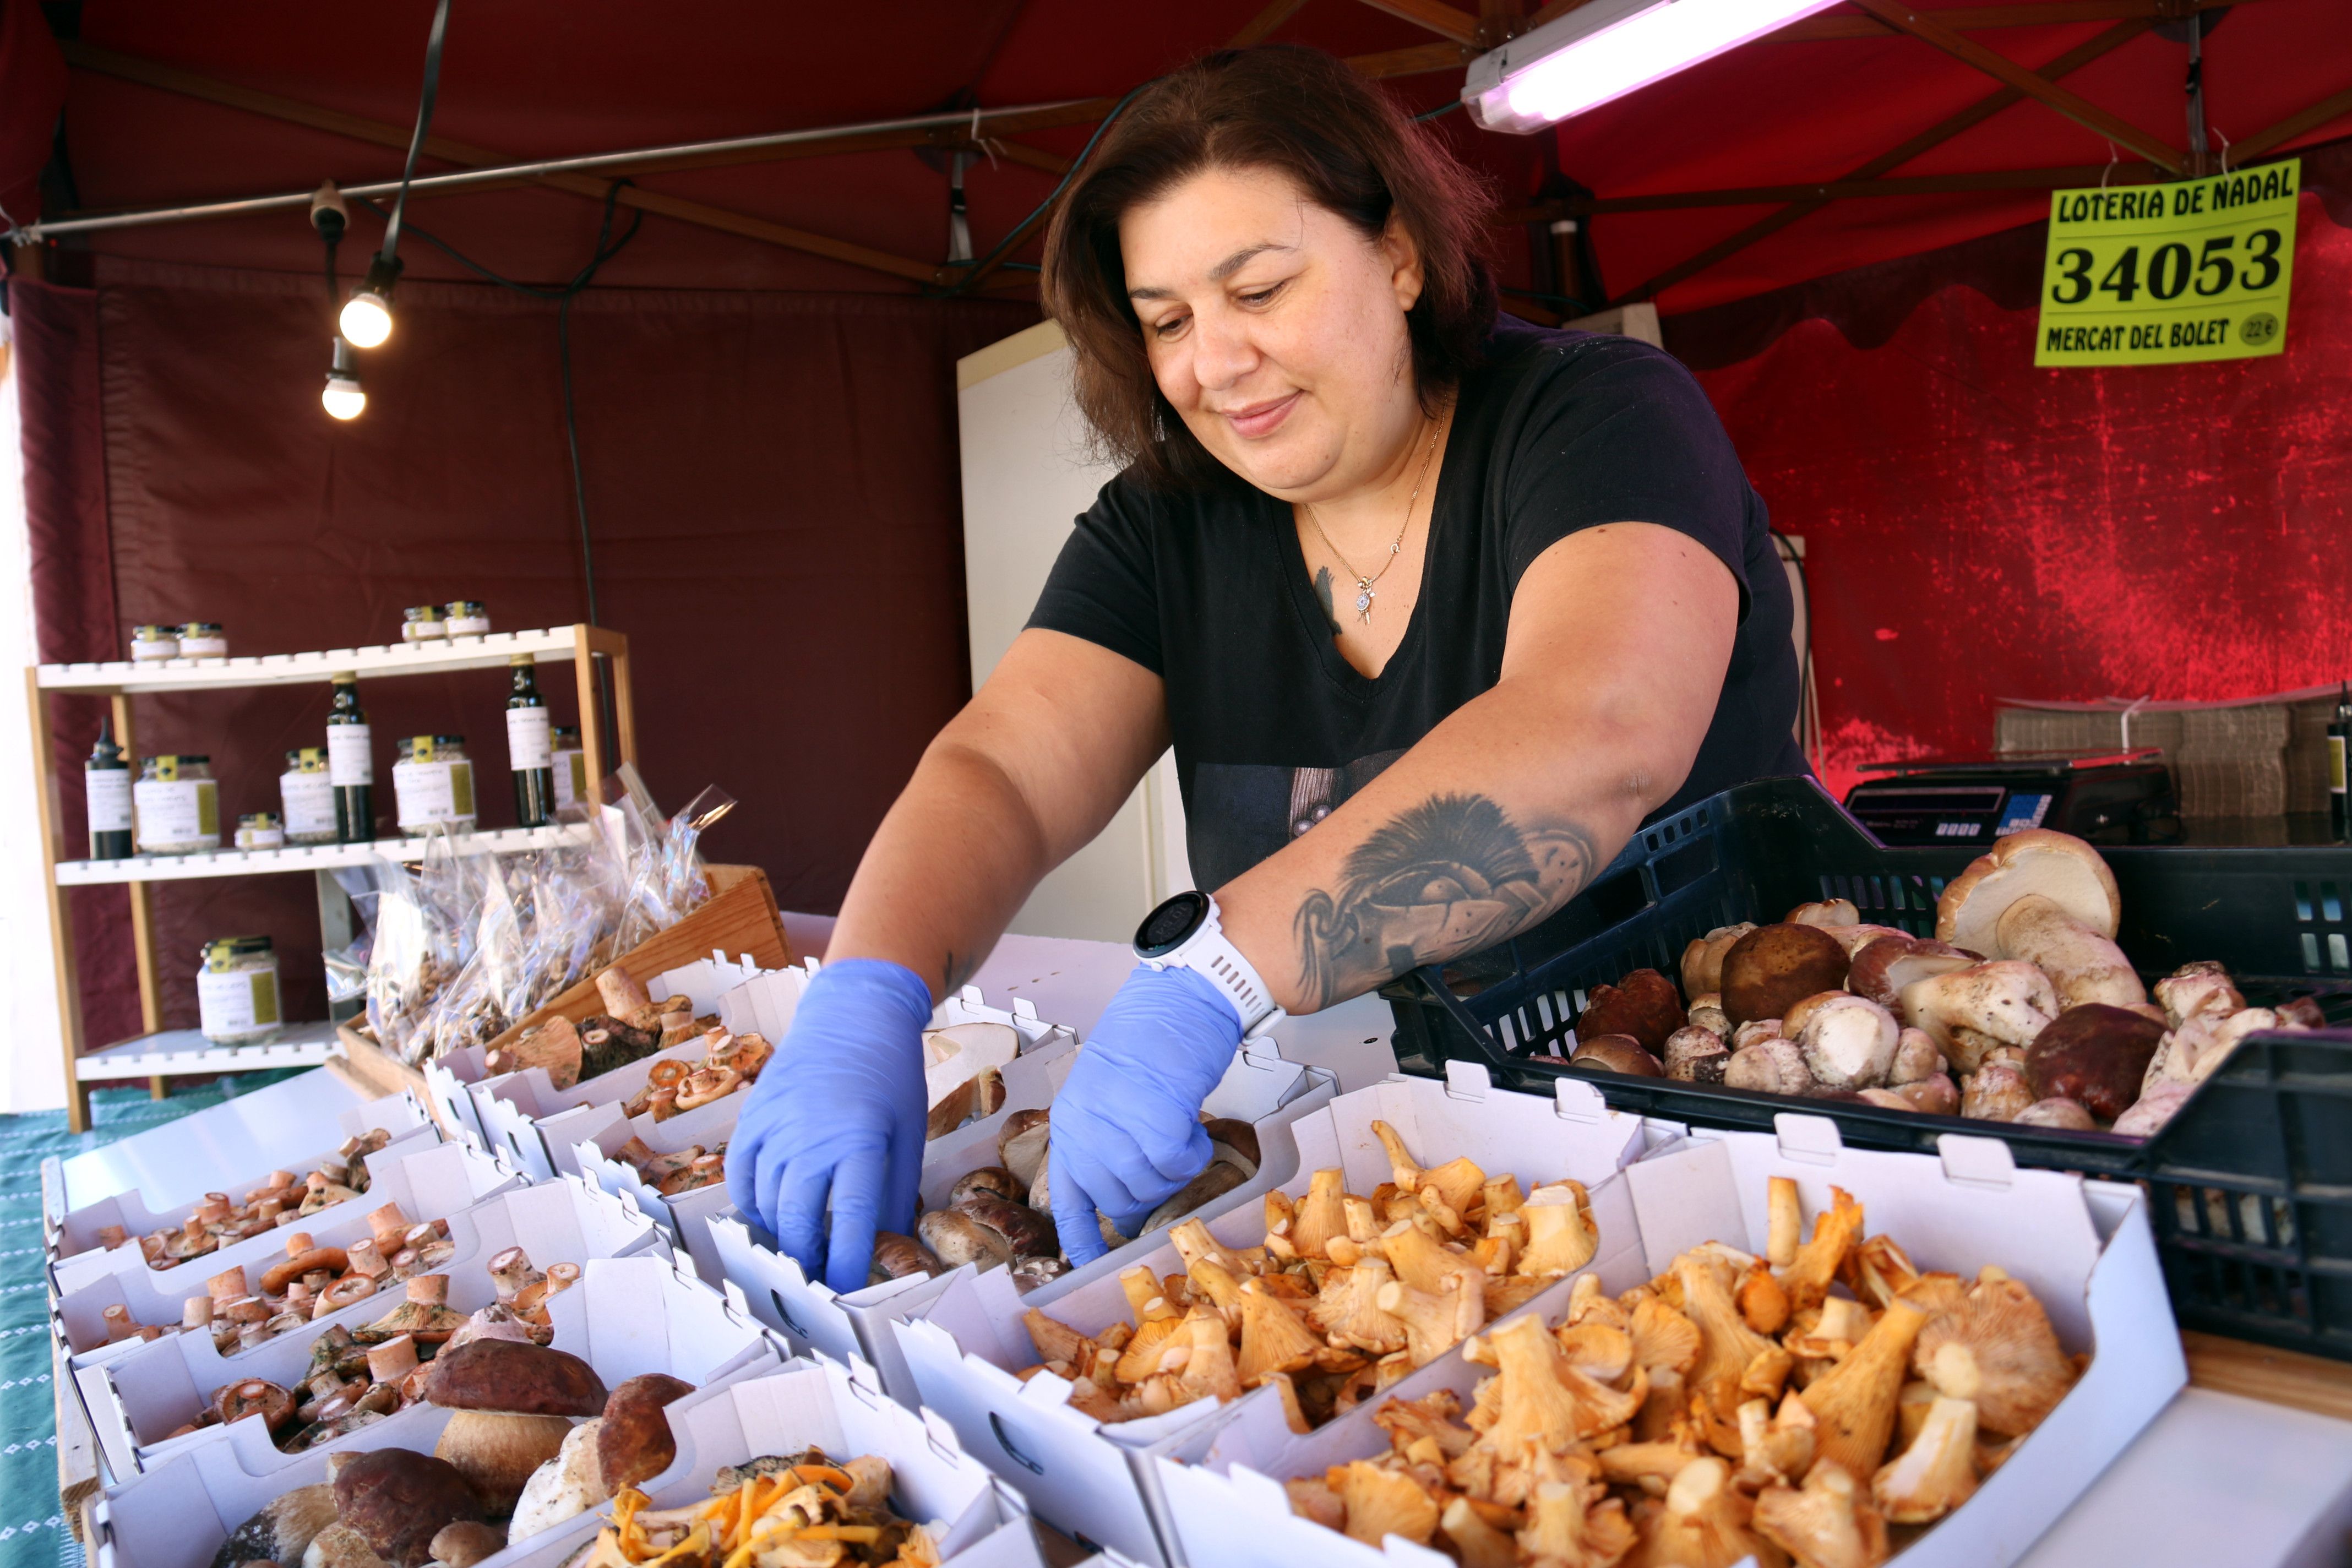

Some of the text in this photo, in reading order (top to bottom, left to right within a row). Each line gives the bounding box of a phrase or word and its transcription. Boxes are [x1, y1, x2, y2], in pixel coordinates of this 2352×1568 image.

[2059, 167, 2293, 222] LOTERIA DE NADAL
[2051, 228, 2282, 304] 34053
[2046, 318, 2230, 352] MERCAT DEL BOLET
[2246, 321, 2262, 337] 22
